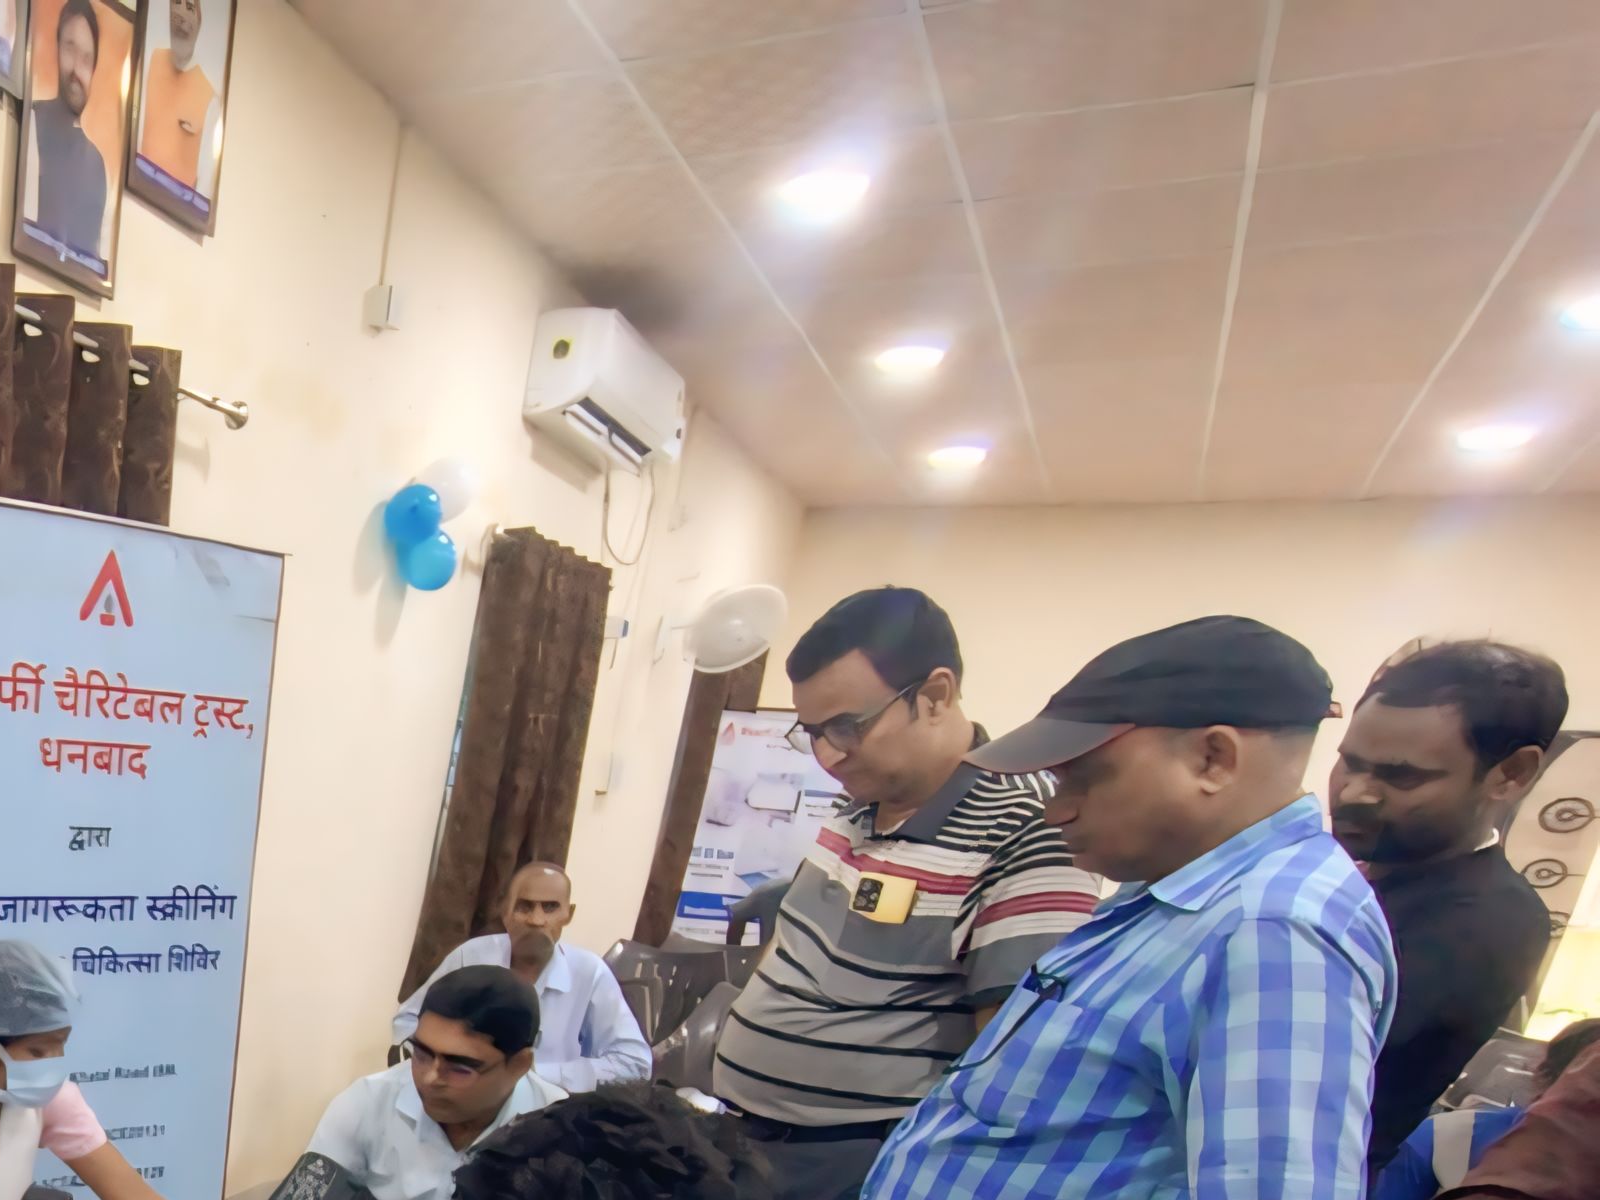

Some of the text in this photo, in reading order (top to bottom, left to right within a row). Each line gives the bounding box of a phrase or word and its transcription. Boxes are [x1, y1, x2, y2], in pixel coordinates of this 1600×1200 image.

[53, 667, 187, 725] चैरिटेबल
[39, 737, 151, 779] धनबाद
[68, 825, 112, 850] द्वारा
[72, 943, 221, 975] चिकित्सा शिविर
